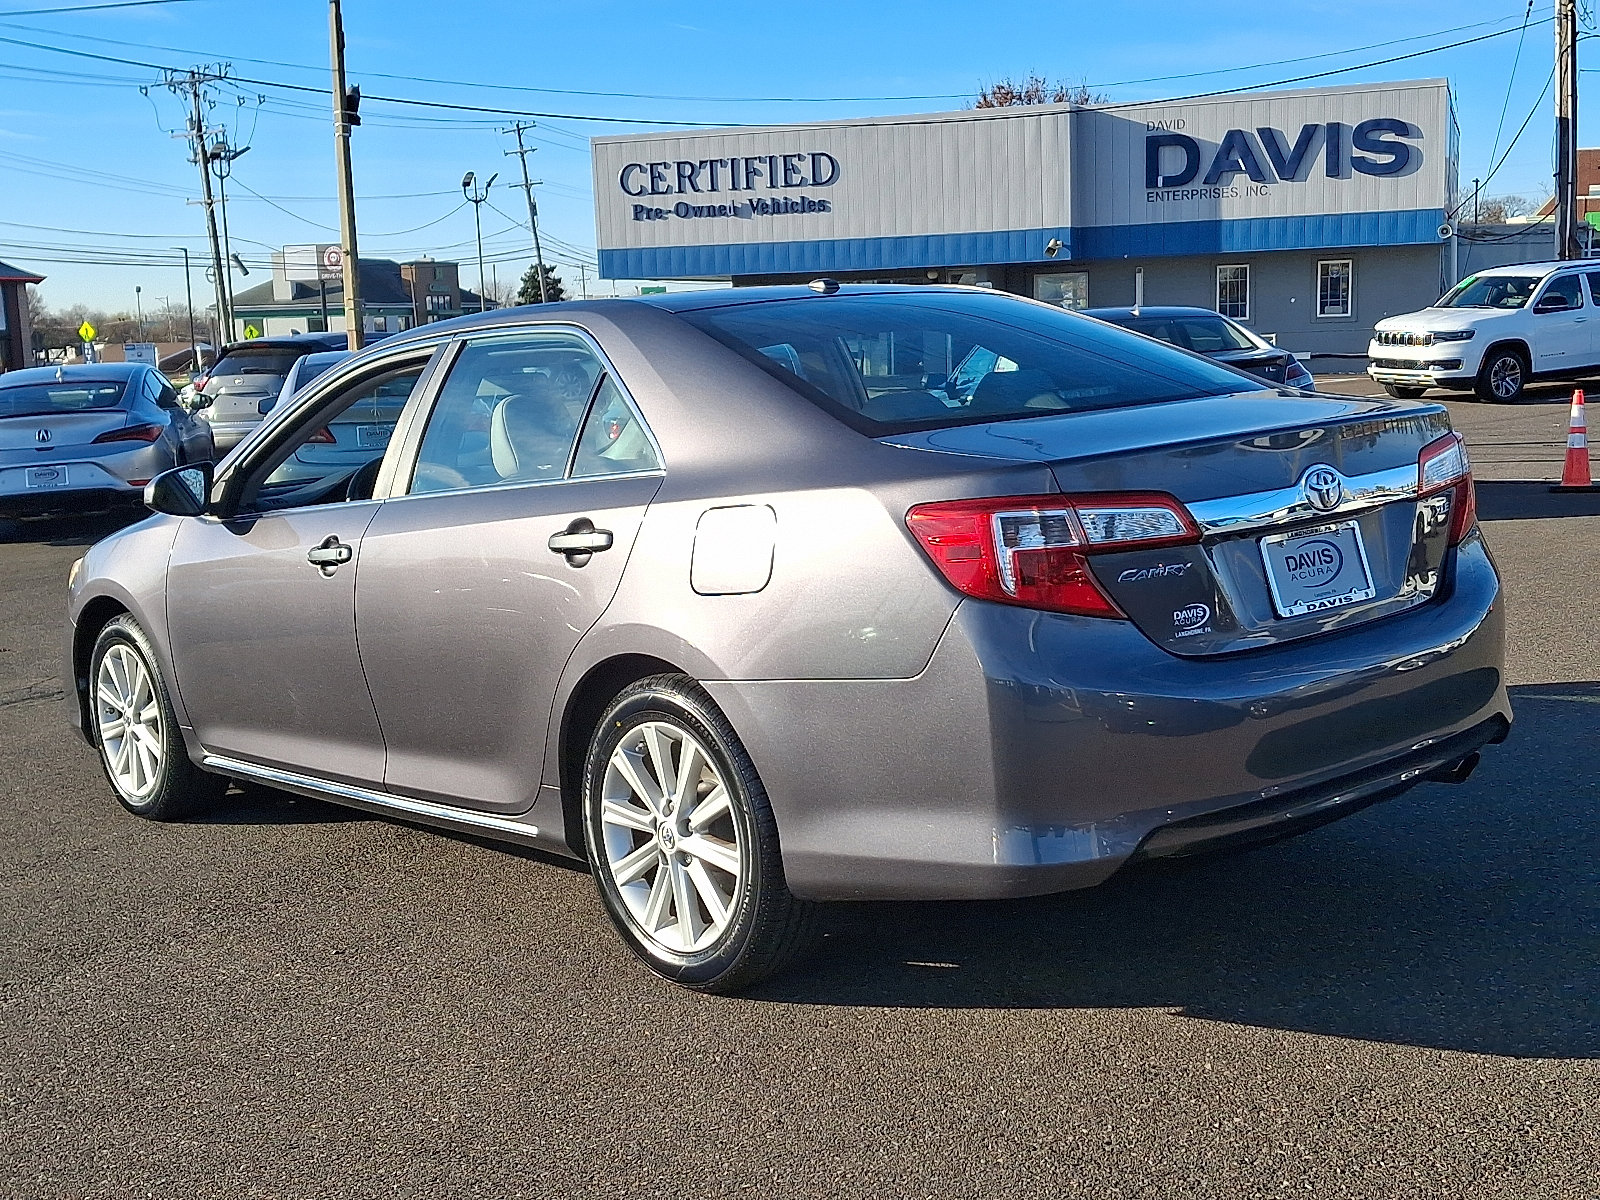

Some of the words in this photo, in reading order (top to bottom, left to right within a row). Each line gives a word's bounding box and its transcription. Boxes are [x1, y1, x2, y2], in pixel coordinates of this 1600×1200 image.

[1146, 119, 1186, 132] DAVID
[1146, 118, 1410, 188] DAVIS
[619, 153, 840, 197] CERTIFIED
[1147, 187, 1242, 203] ENTERPRISES,
[1246, 185, 1272, 198] INC.
[631, 199, 737, 221] Pre-Owned
[747, 195, 831, 216] Vehicles
[1285, 548, 1334, 572] DAVIS
[1117, 562, 1193, 583] CAMRY
[1291, 565, 1334, 581] ACURA
[1307, 595, 1354, 612] DAVIS
[1173, 607, 1204, 621] DAVIS
[1174, 616, 1202, 626] ACURA
